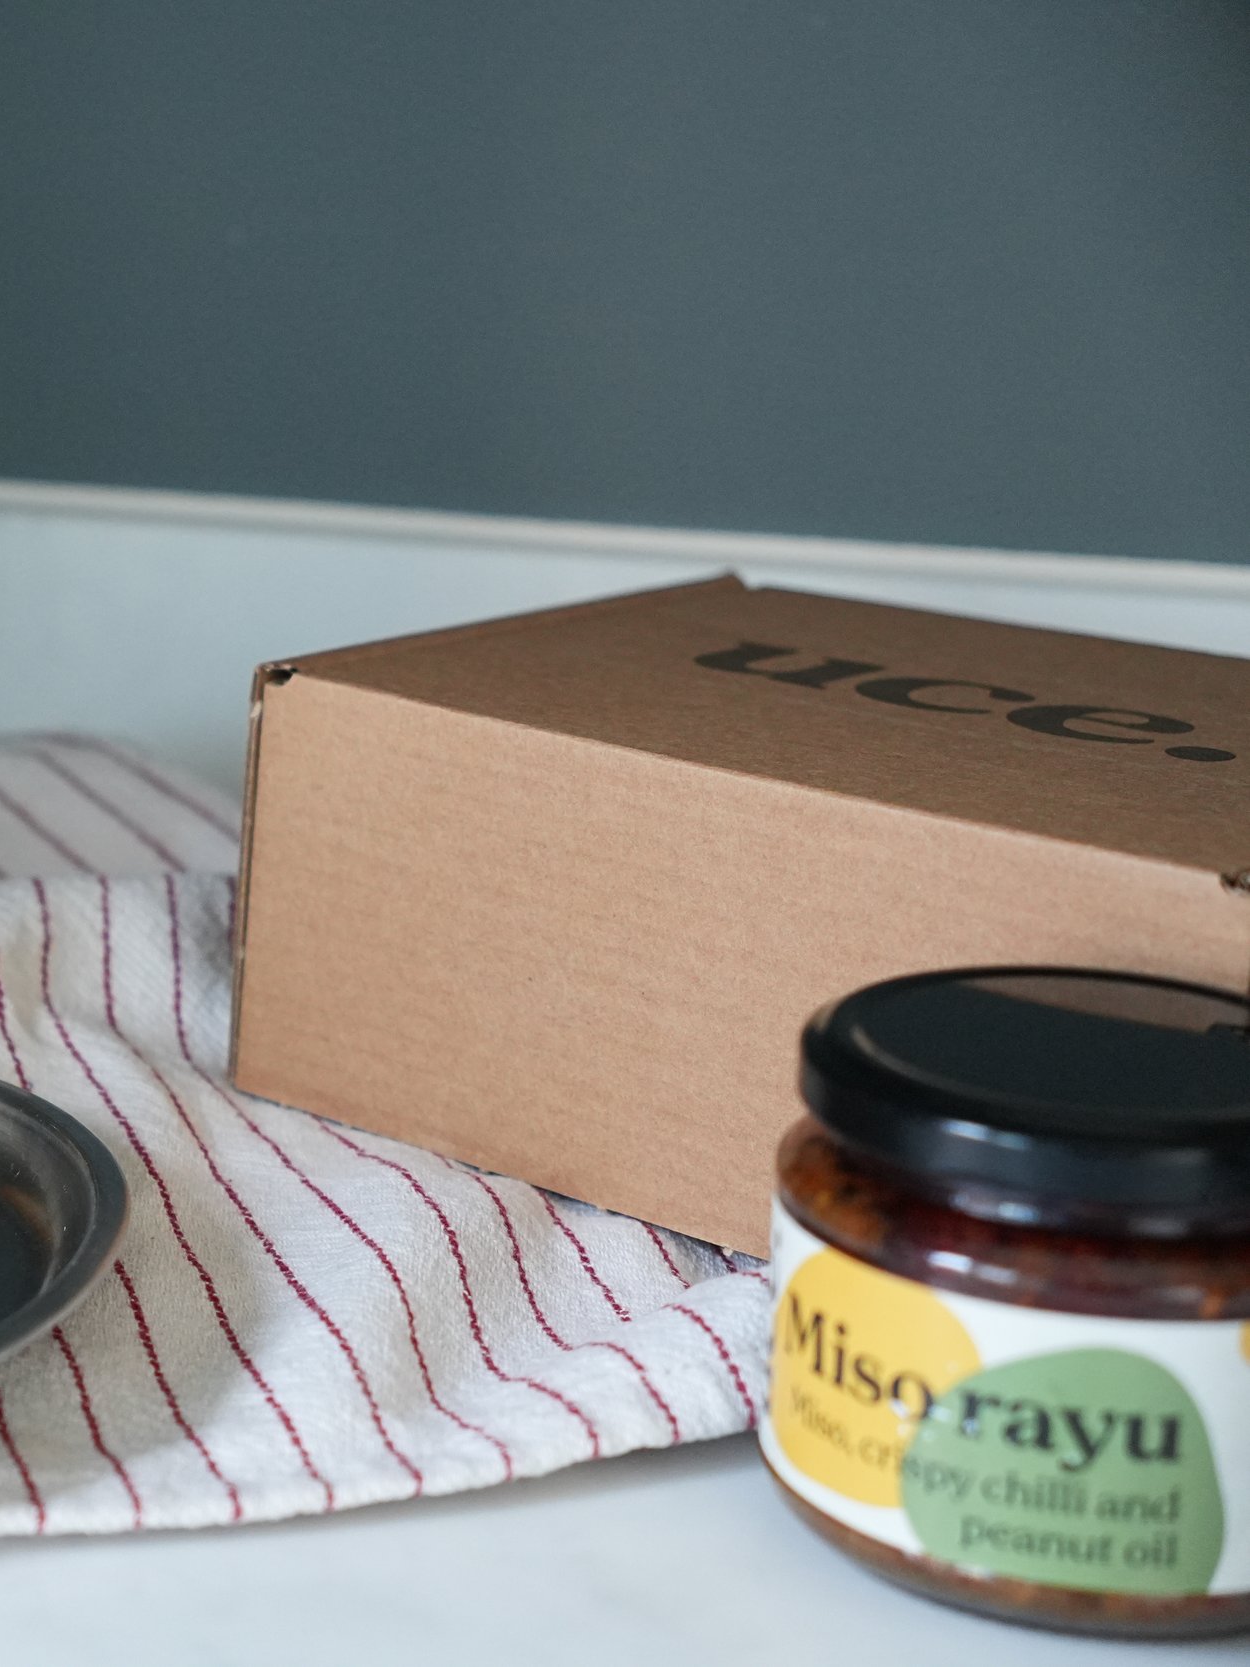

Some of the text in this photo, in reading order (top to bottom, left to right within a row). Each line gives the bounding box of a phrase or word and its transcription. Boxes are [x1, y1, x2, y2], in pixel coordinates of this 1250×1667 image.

[693, 641, 1236, 762] uce.
[784, 1290, 935, 1421] Miso
[958, 1386, 1184, 1472] rayu
[858, 1435, 974, 1502] crispy
[980, 1466, 1088, 1513] chilli
[1095, 1484, 1181, 1526] and
[959, 1515, 1179, 1570] peanut oil
